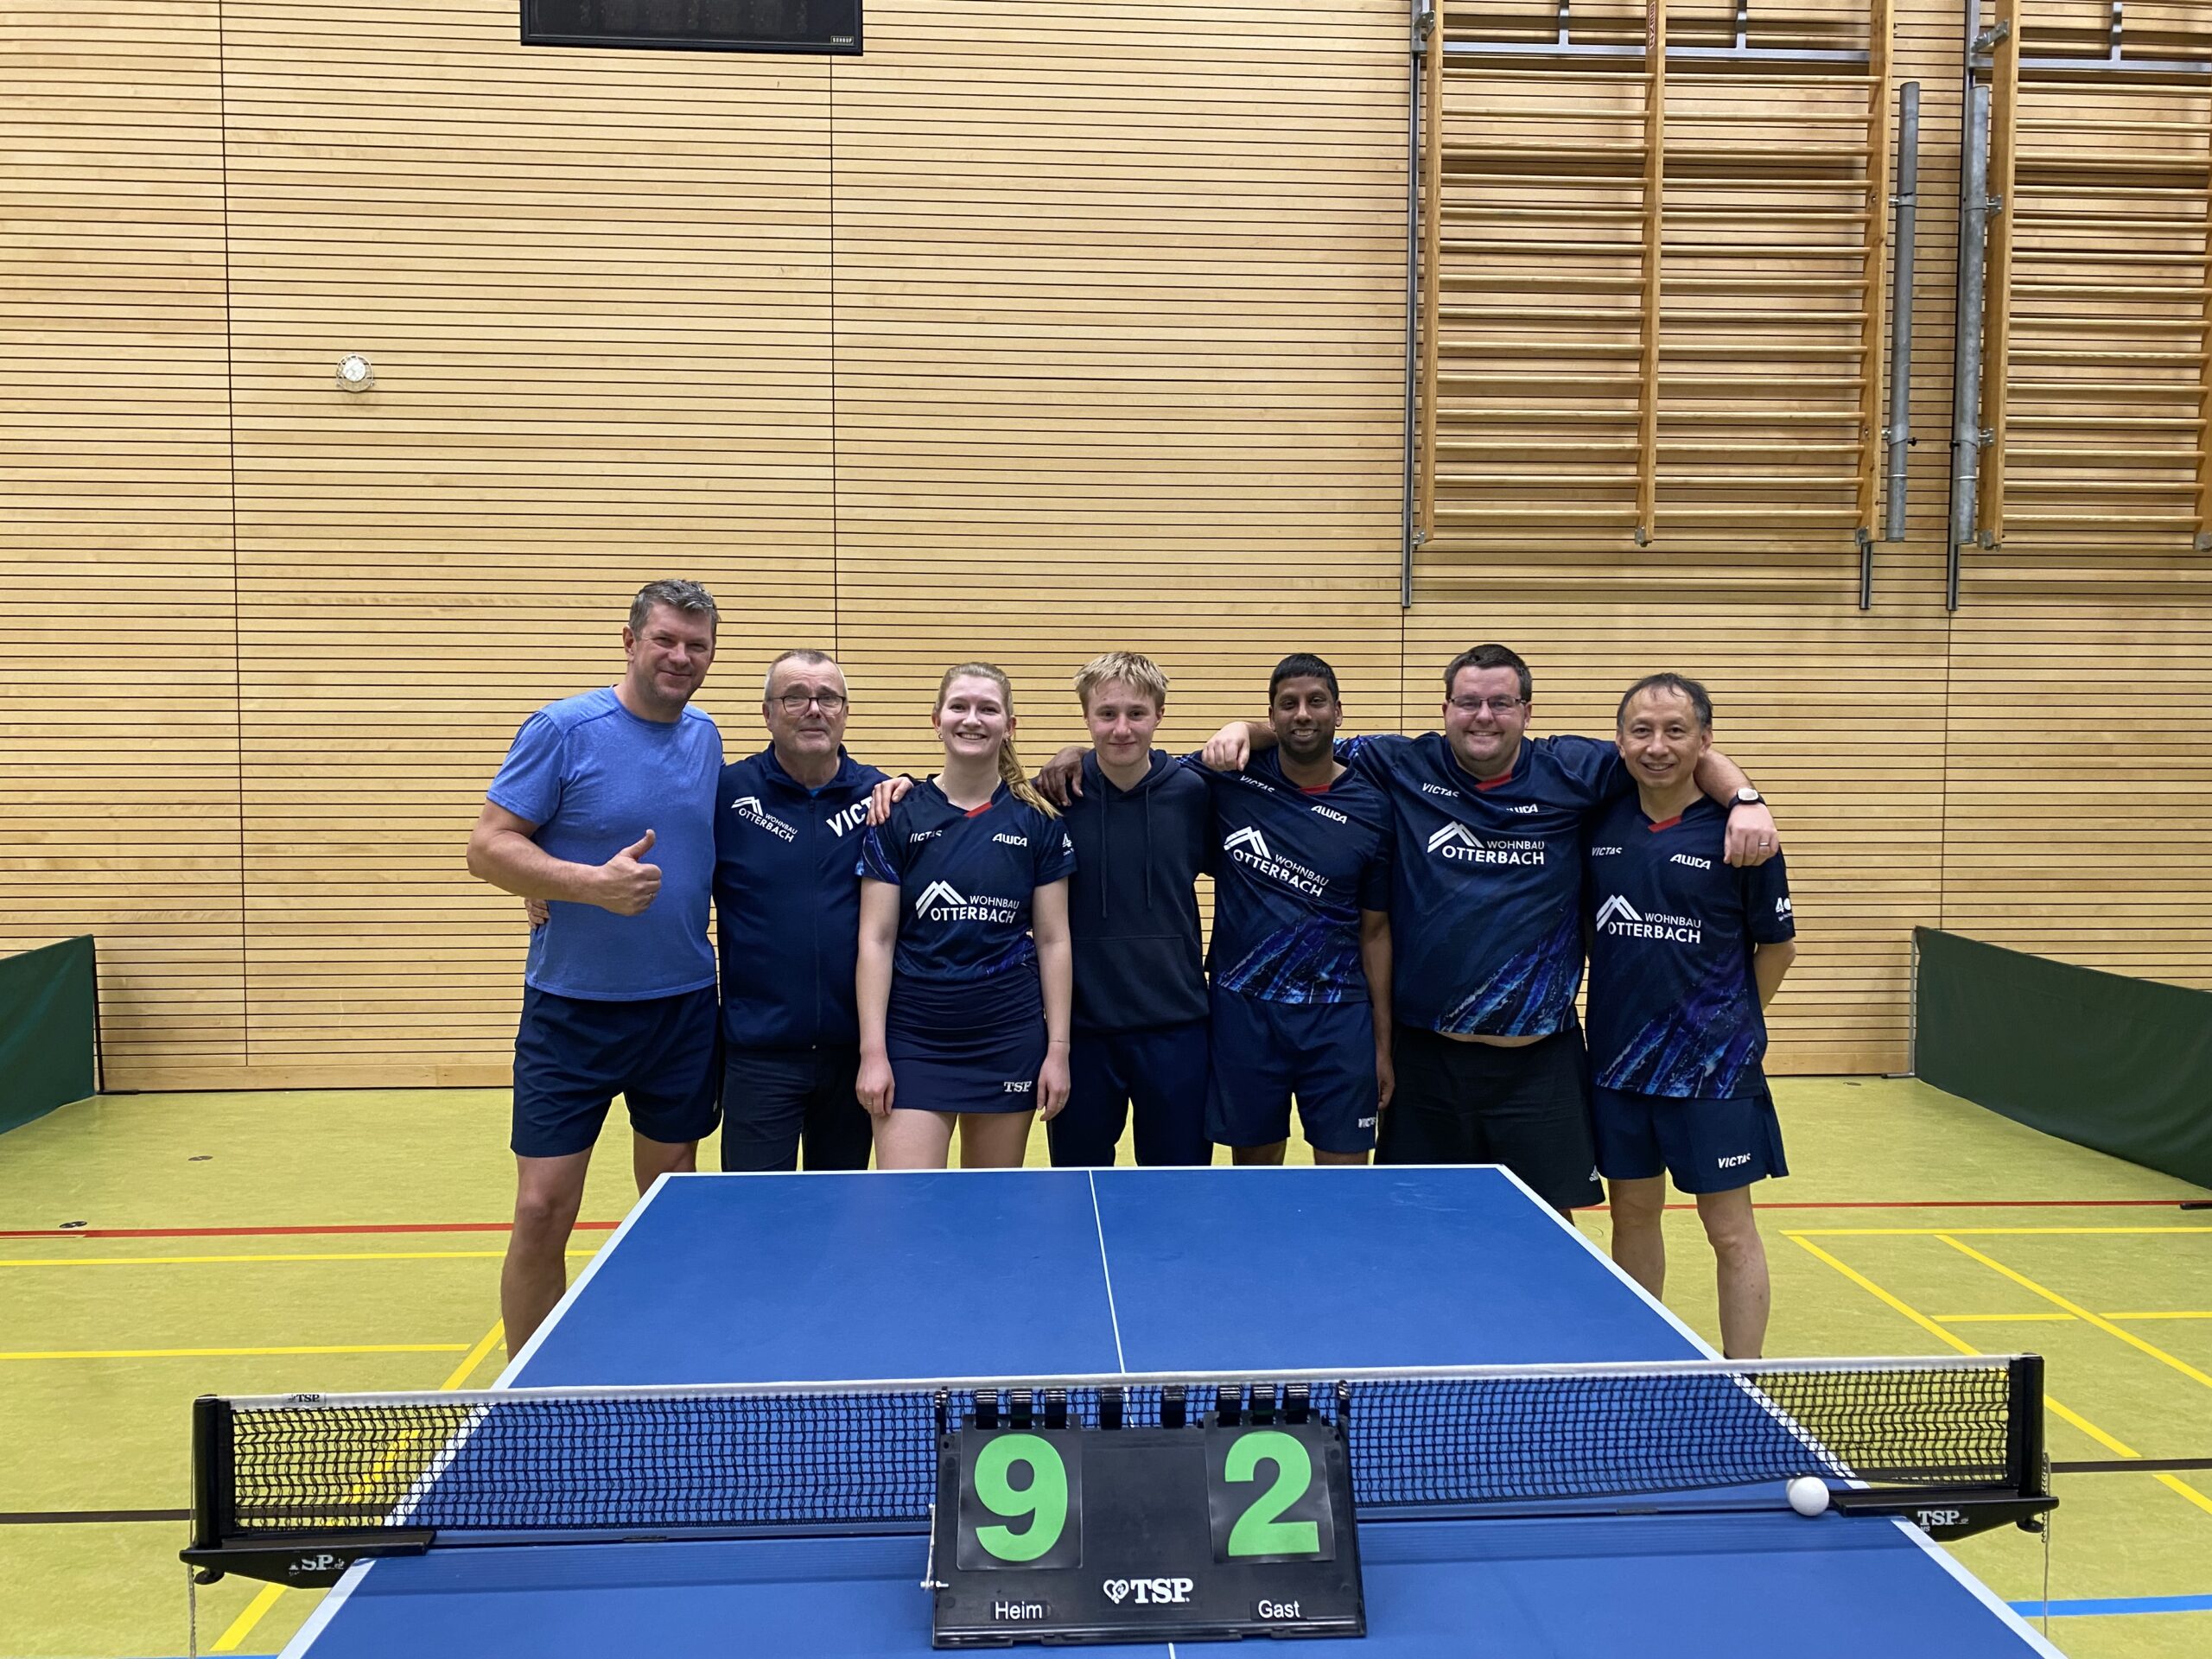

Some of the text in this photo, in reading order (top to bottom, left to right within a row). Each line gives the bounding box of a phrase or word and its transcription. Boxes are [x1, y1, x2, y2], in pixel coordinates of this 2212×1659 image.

[738, 807, 795, 843] OTTERBACH
[765, 812, 798, 836] WOHNBAU
[1441, 844, 1544, 865] OTTERBACH
[1486, 840, 1545, 850] WOHNBAU
[1591, 846, 1623, 857] VICTAS
[1233, 849, 1324, 898] OTTERBACH
[1275, 853, 1330, 887] WOHNBAU
[969, 895, 1020, 910] WOHNBAU
[930, 906, 1016, 924] OTTERBACH
[1644, 912, 1701, 929] WOHNBAU
[1607, 921, 1701, 944] OTTERBACH
[1003, 1080, 1033, 1093] TSP
[974, 1433, 1069, 1562] 9
[1224, 1430, 1321, 1557] 2
[995, 1600, 1043, 1620] Heim
[1257, 1599, 1300, 1618] Gast
